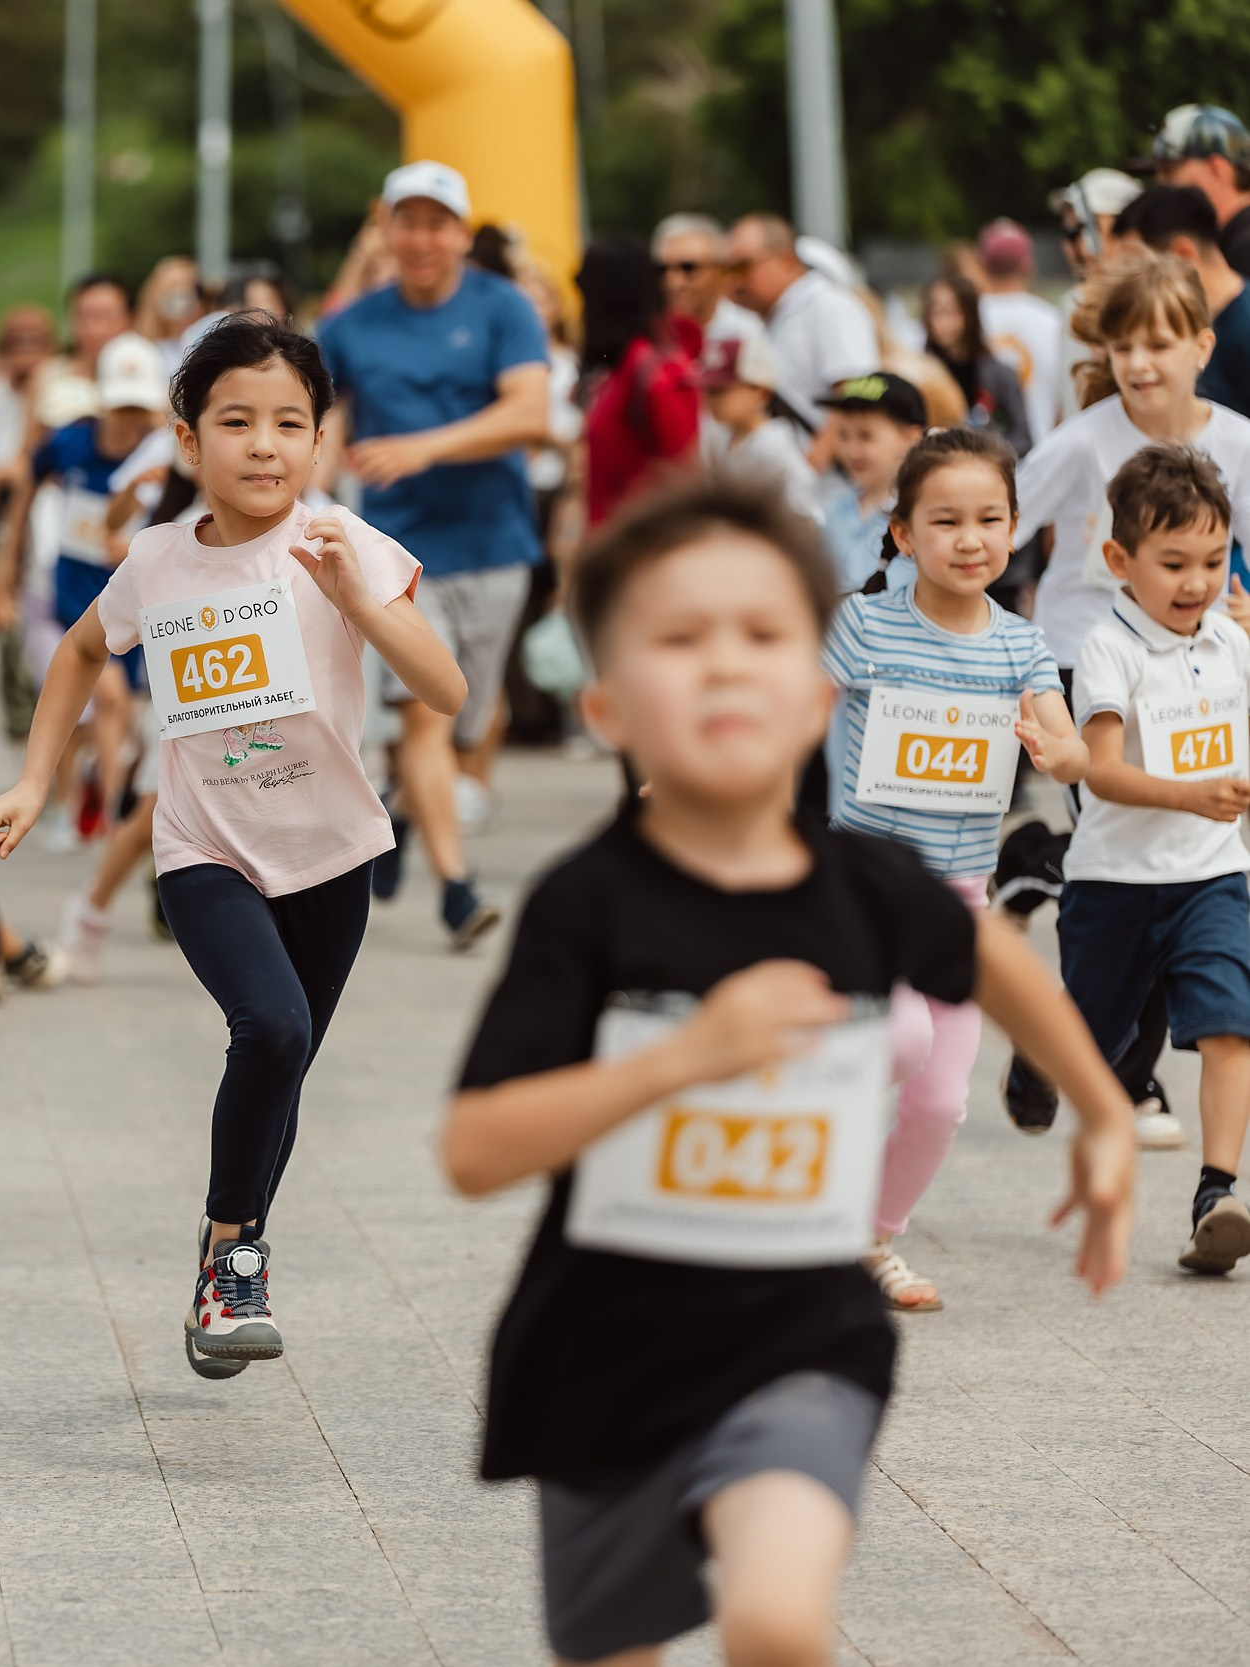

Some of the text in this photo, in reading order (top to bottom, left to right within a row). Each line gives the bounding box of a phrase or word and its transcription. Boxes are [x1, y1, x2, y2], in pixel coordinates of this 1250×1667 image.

[150, 600, 278, 639] LEONE D'ORO
[182, 644, 257, 693] 462
[168, 691, 294, 724] БЛАГОТВОРИТЕЛЬНЫЙ ЗАБЕГ
[883, 704, 938, 723] LEONE
[1151, 705, 1194, 724] LEONE
[906, 739, 978, 778] 044
[1178, 727, 1227, 768] 471
[220, 778, 240, 786] BEAR
[250, 769, 277, 781] RALPH
[277, 760, 309, 774] LAUREN
[672, 1117, 820, 1192] 042
